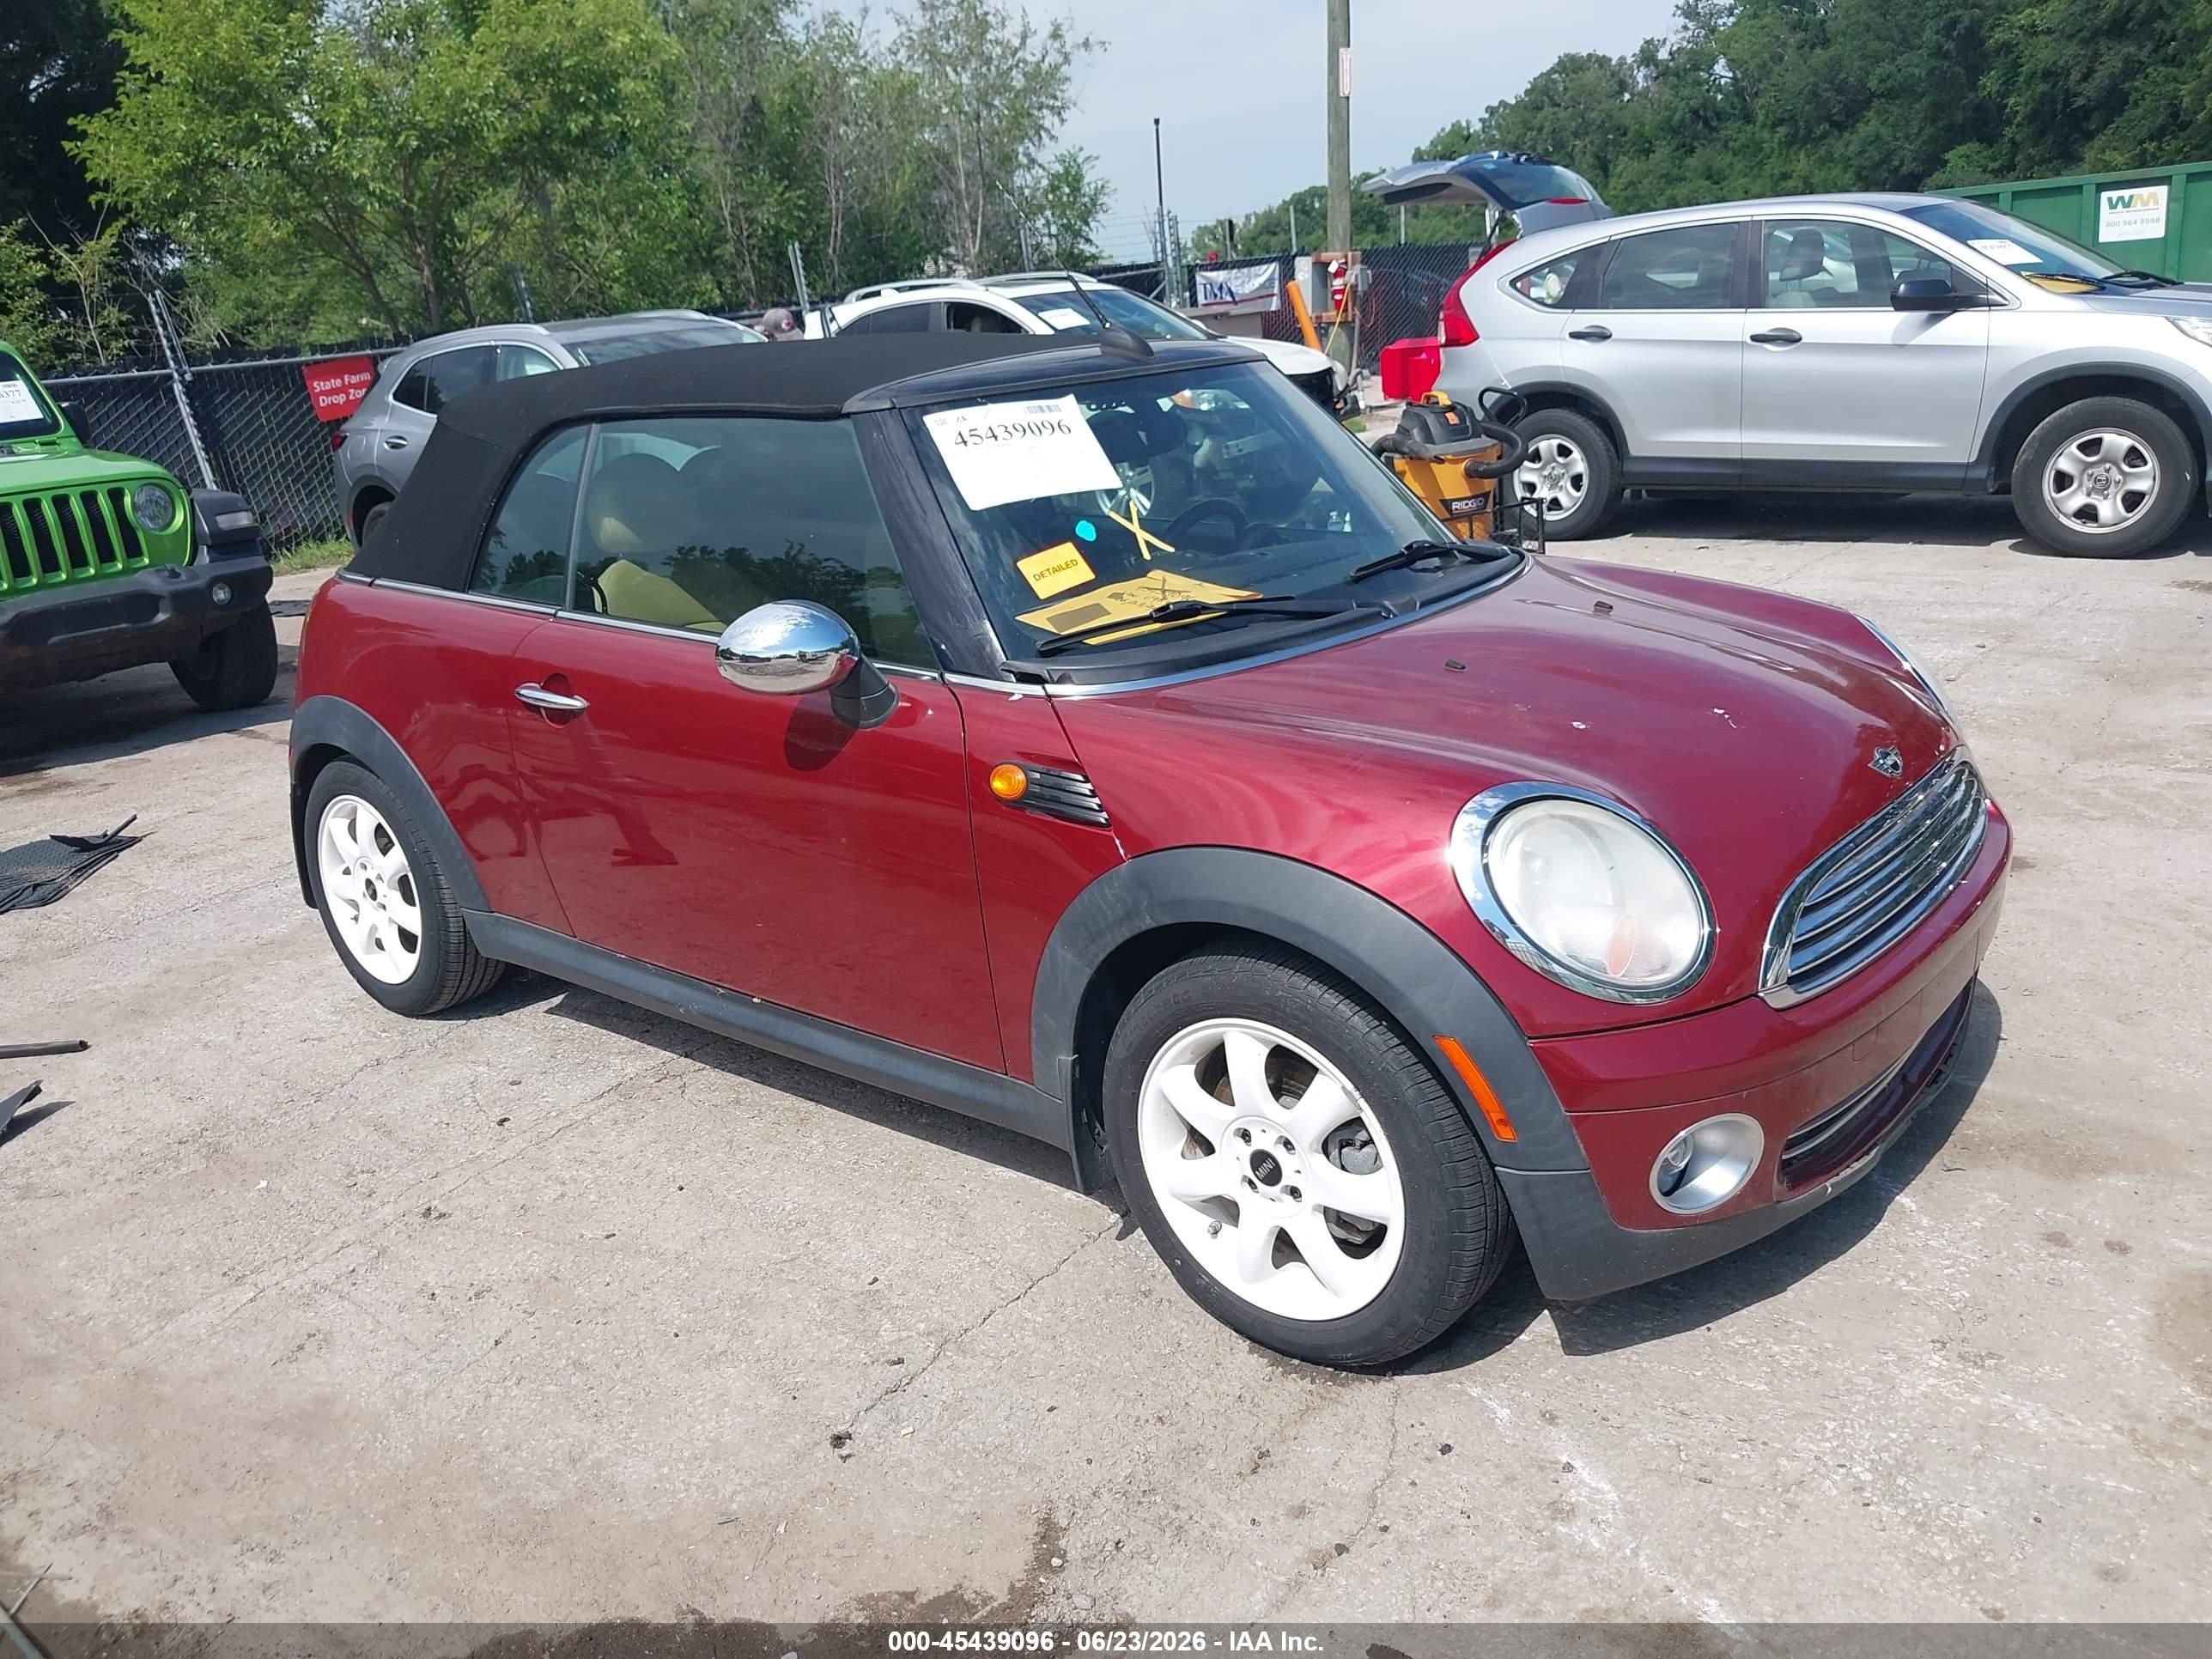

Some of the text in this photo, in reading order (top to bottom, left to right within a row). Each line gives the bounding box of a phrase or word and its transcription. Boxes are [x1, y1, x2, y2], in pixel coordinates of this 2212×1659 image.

[2106, 192, 2159, 210] WM
[313, 372, 370, 392] State Farm
[319, 393, 346, 407] Drop
[954, 419, 1072, 447] 45439096
[1032, 559, 1079, 581] DETAILED
[1255, 1158, 1276, 1180] MINI
